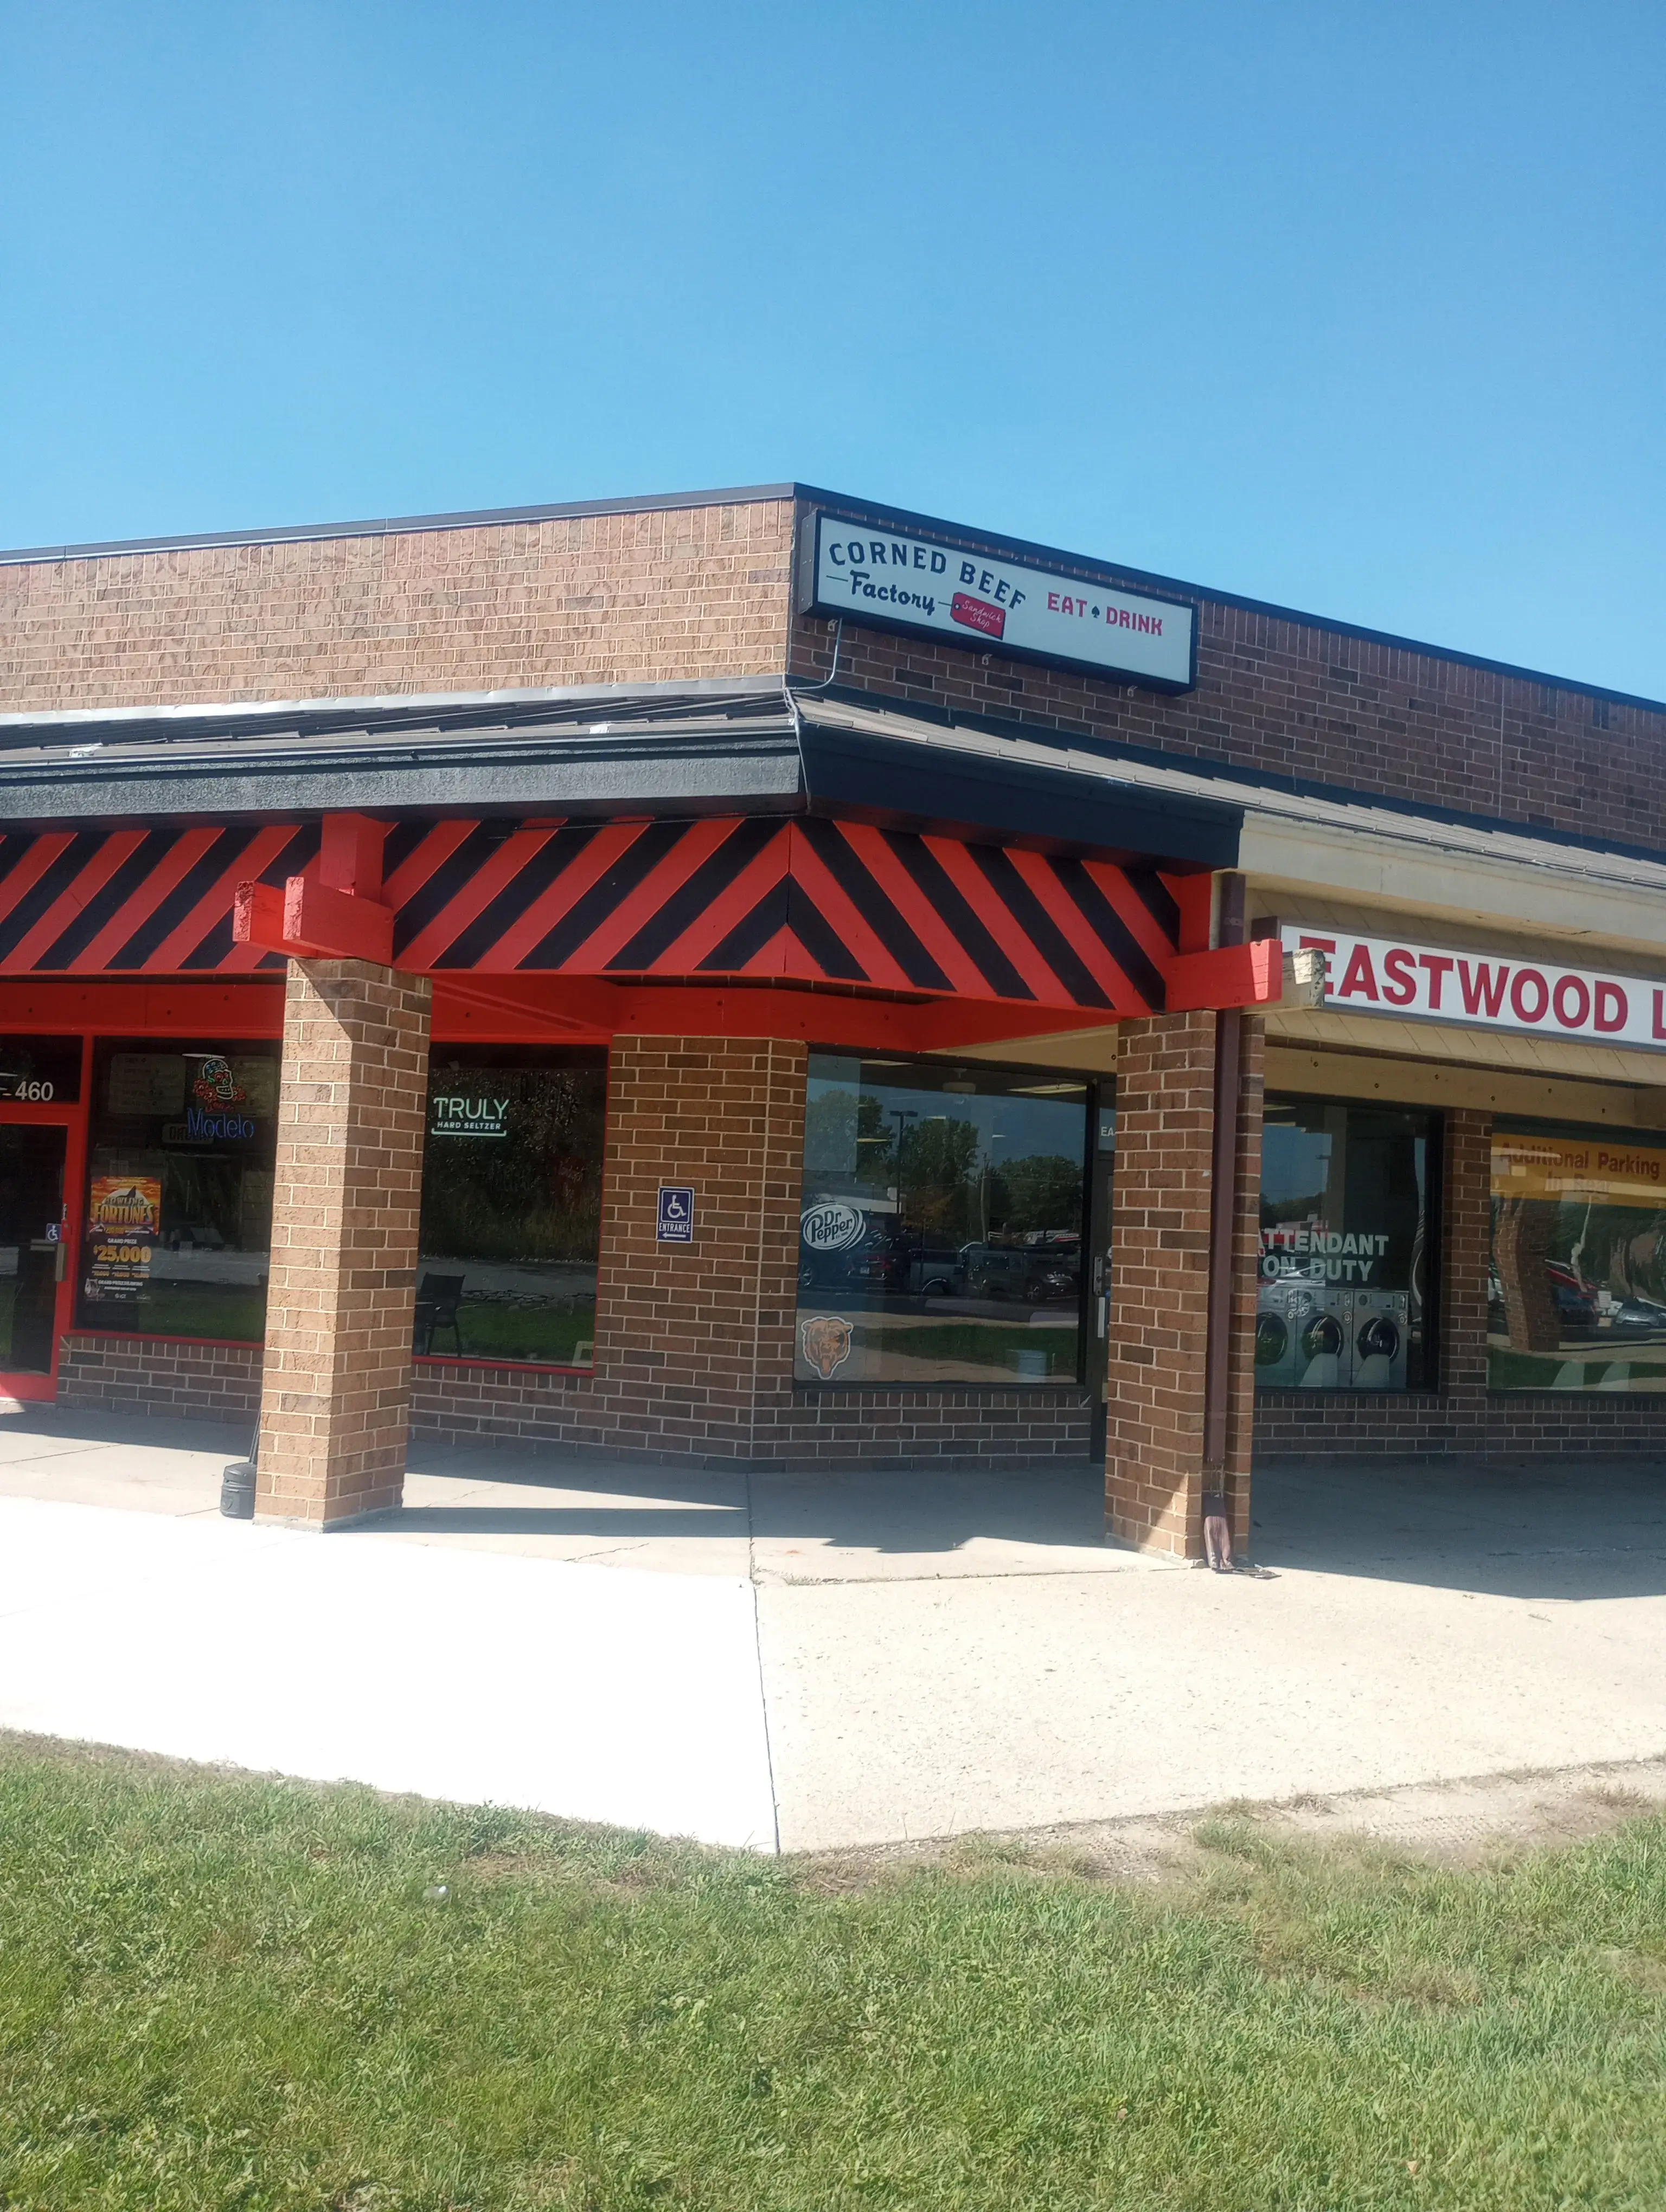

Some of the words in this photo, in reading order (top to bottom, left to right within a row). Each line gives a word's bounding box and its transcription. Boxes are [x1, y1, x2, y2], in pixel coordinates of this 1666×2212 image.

[829, 542, 946, 574] CORNED
[959, 561, 1026, 609] BEEF
[849, 569, 935, 616] Factory
[962, 600, 1002, 623] Sandwich
[970, 612, 990, 629] Shop
[1047, 591, 1088, 618] EAT
[1106, 606, 1163, 636] DRINK
[15, 1081, 54, 1102] 460
[187, 1107, 254, 1138] Modelo
[464, 1122, 501, 1130] SELTZER
[1597, 1151, 1661, 1180] Parking
[93, 1203, 155, 1225] FORTUNES
[824, 1210, 842, 1227] Dr
[658, 1222, 690, 1233] ENTRANCE
[805, 1214, 853, 1244] Pepper
[93, 1245, 152, 1263] $25,000
[1263, 1255, 1296, 1277] ON
[1310, 1257, 1374, 1282] DUTY
